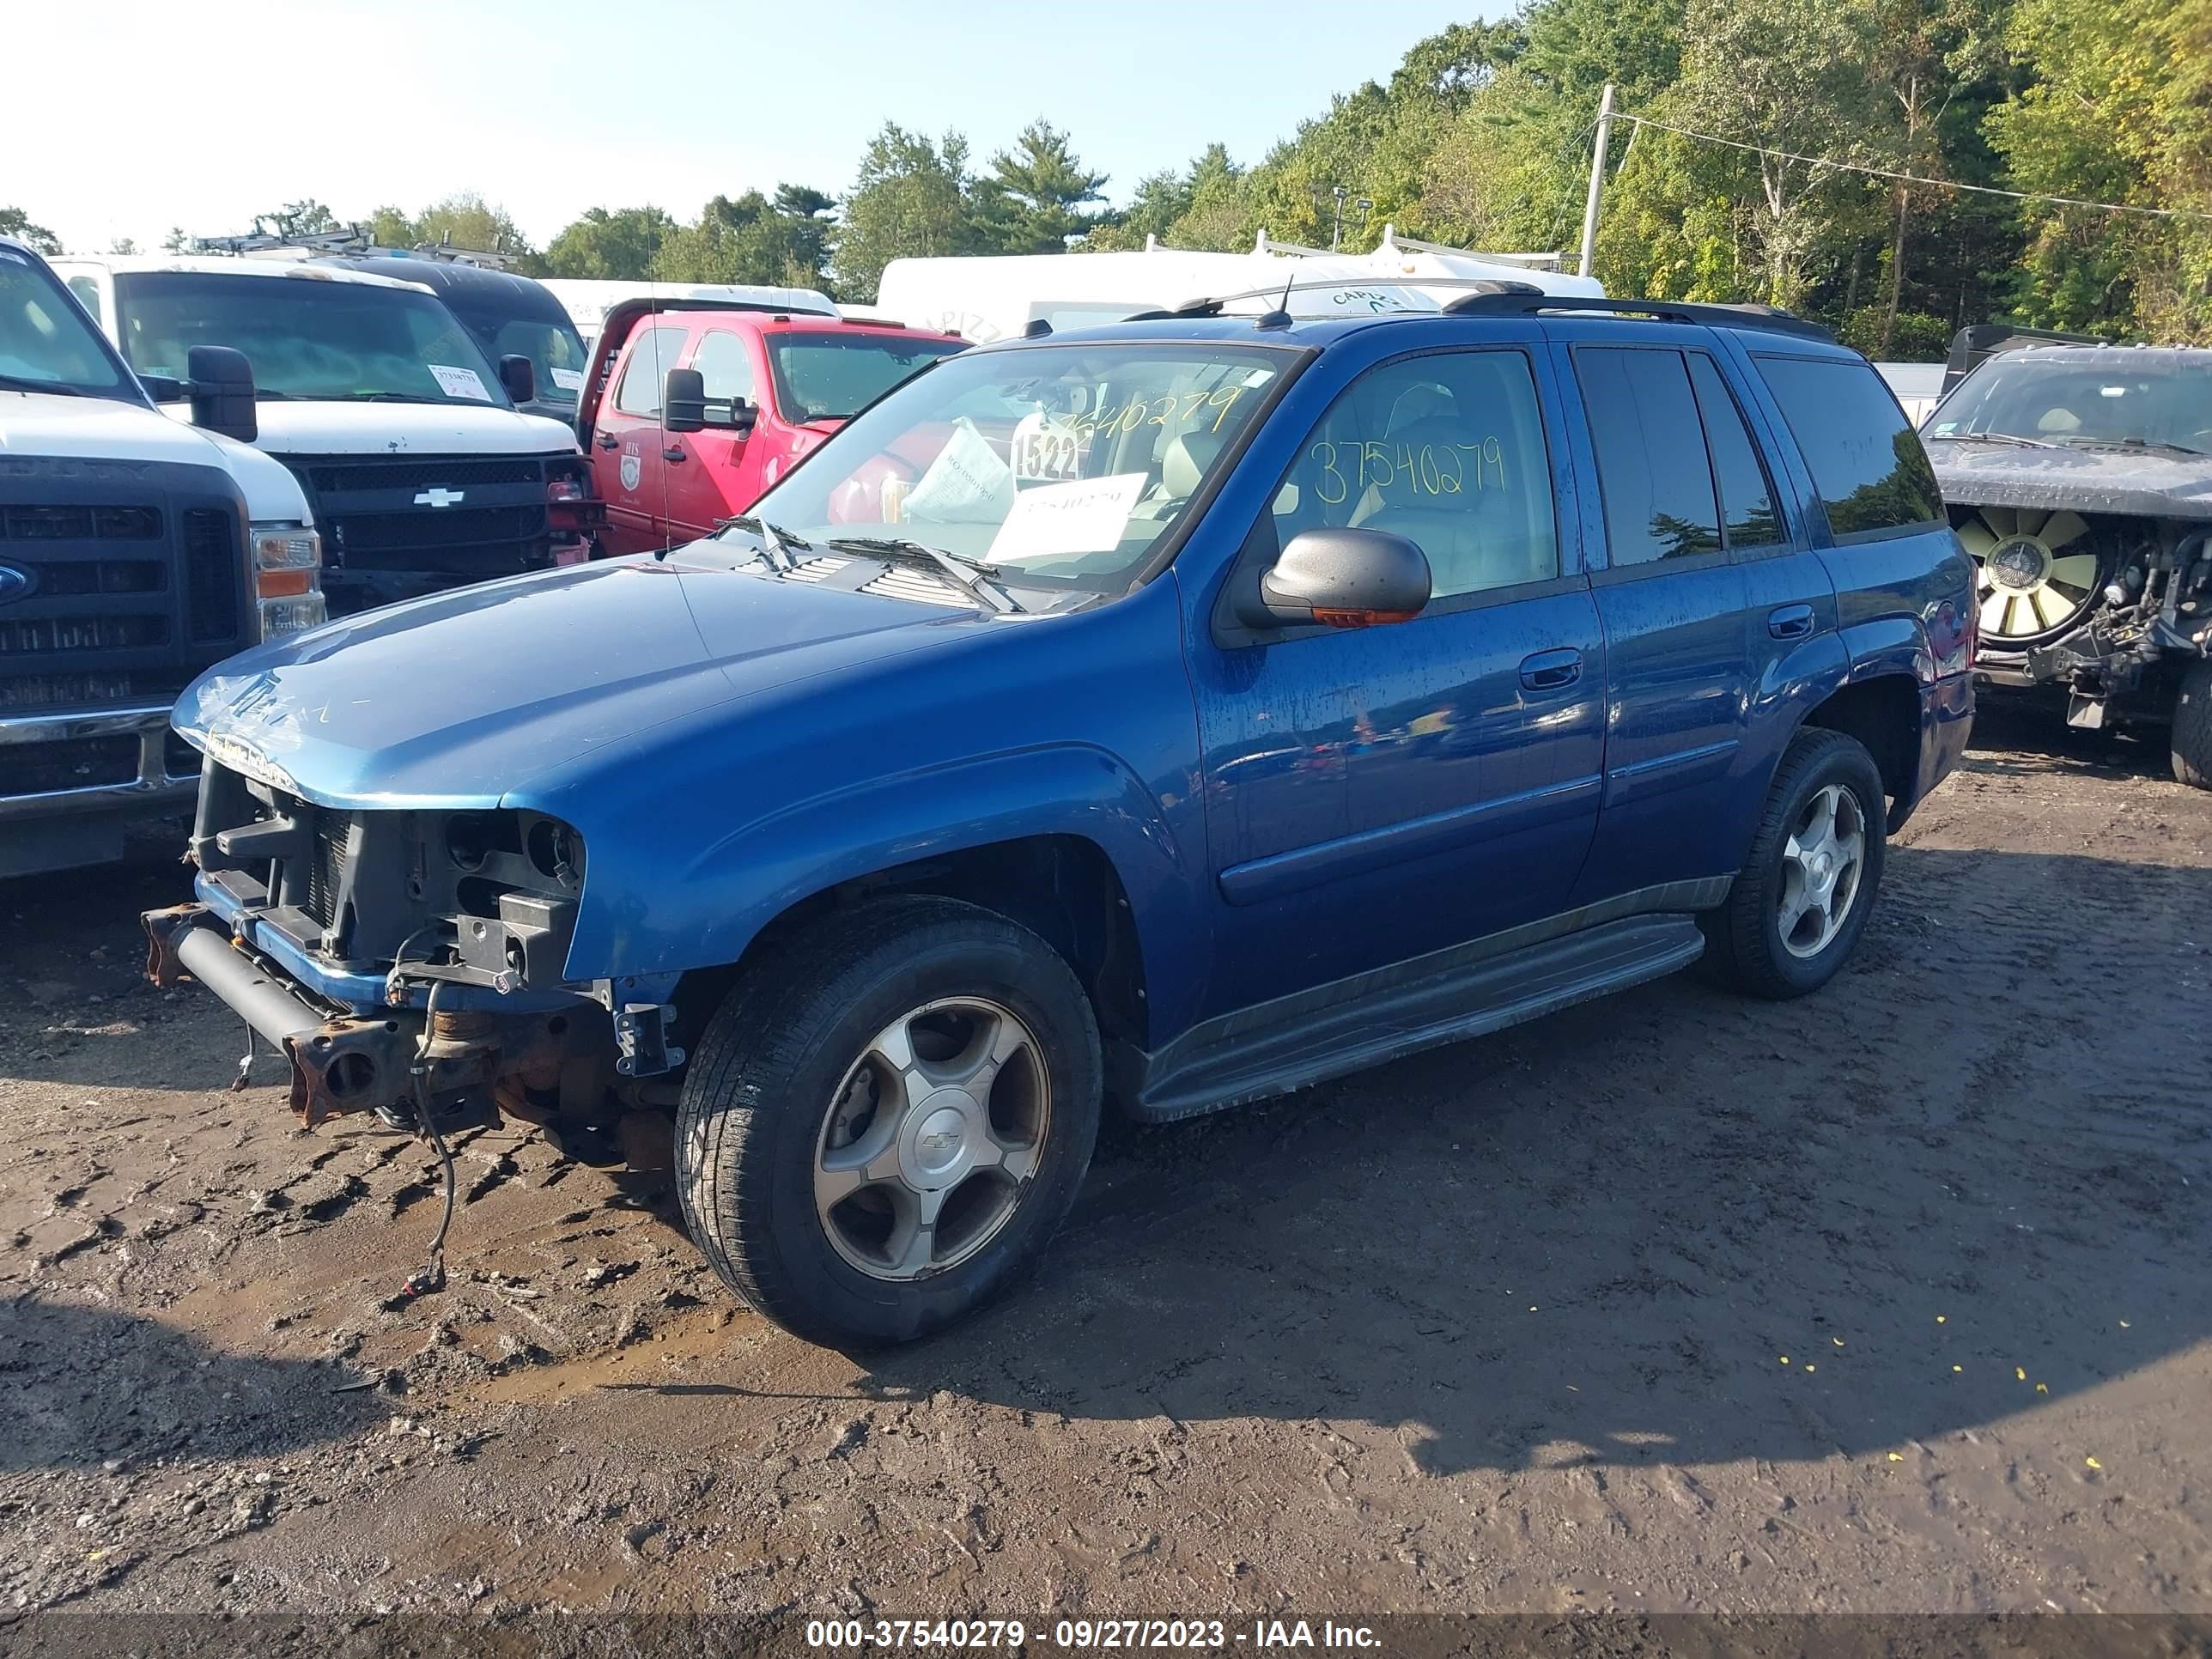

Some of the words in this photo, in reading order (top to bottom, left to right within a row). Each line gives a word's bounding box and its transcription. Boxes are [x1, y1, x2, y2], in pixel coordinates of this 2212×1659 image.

[1334, 290, 1407, 310] CAPIZZ
[1016, 434, 1076, 480] 1522
[1310, 435, 1506, 505] 37540279
